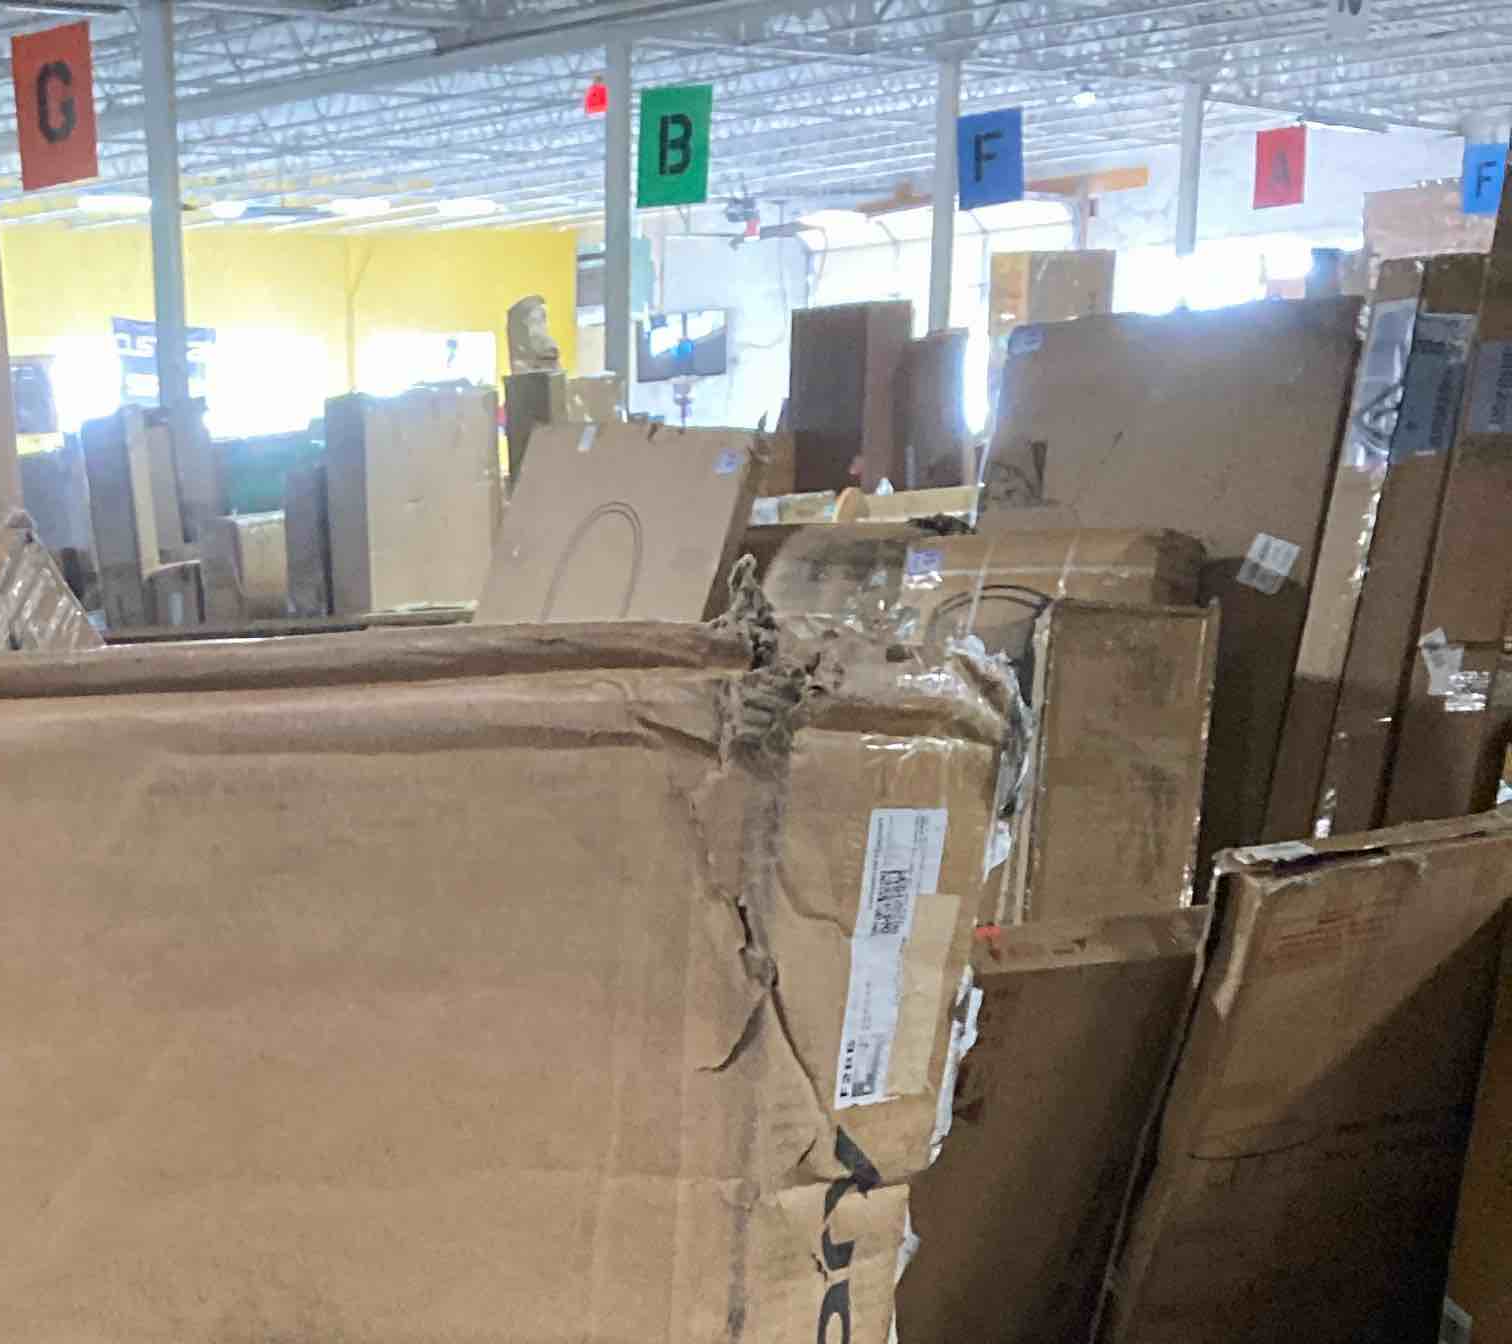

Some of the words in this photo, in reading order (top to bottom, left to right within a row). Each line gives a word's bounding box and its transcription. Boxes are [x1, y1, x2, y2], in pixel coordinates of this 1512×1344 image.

[37, 60, 78, 144] G
[658, 113, 693, 176] B
[973, 128, 1004, 182] F
[1474, 160, 1498, 200] F
